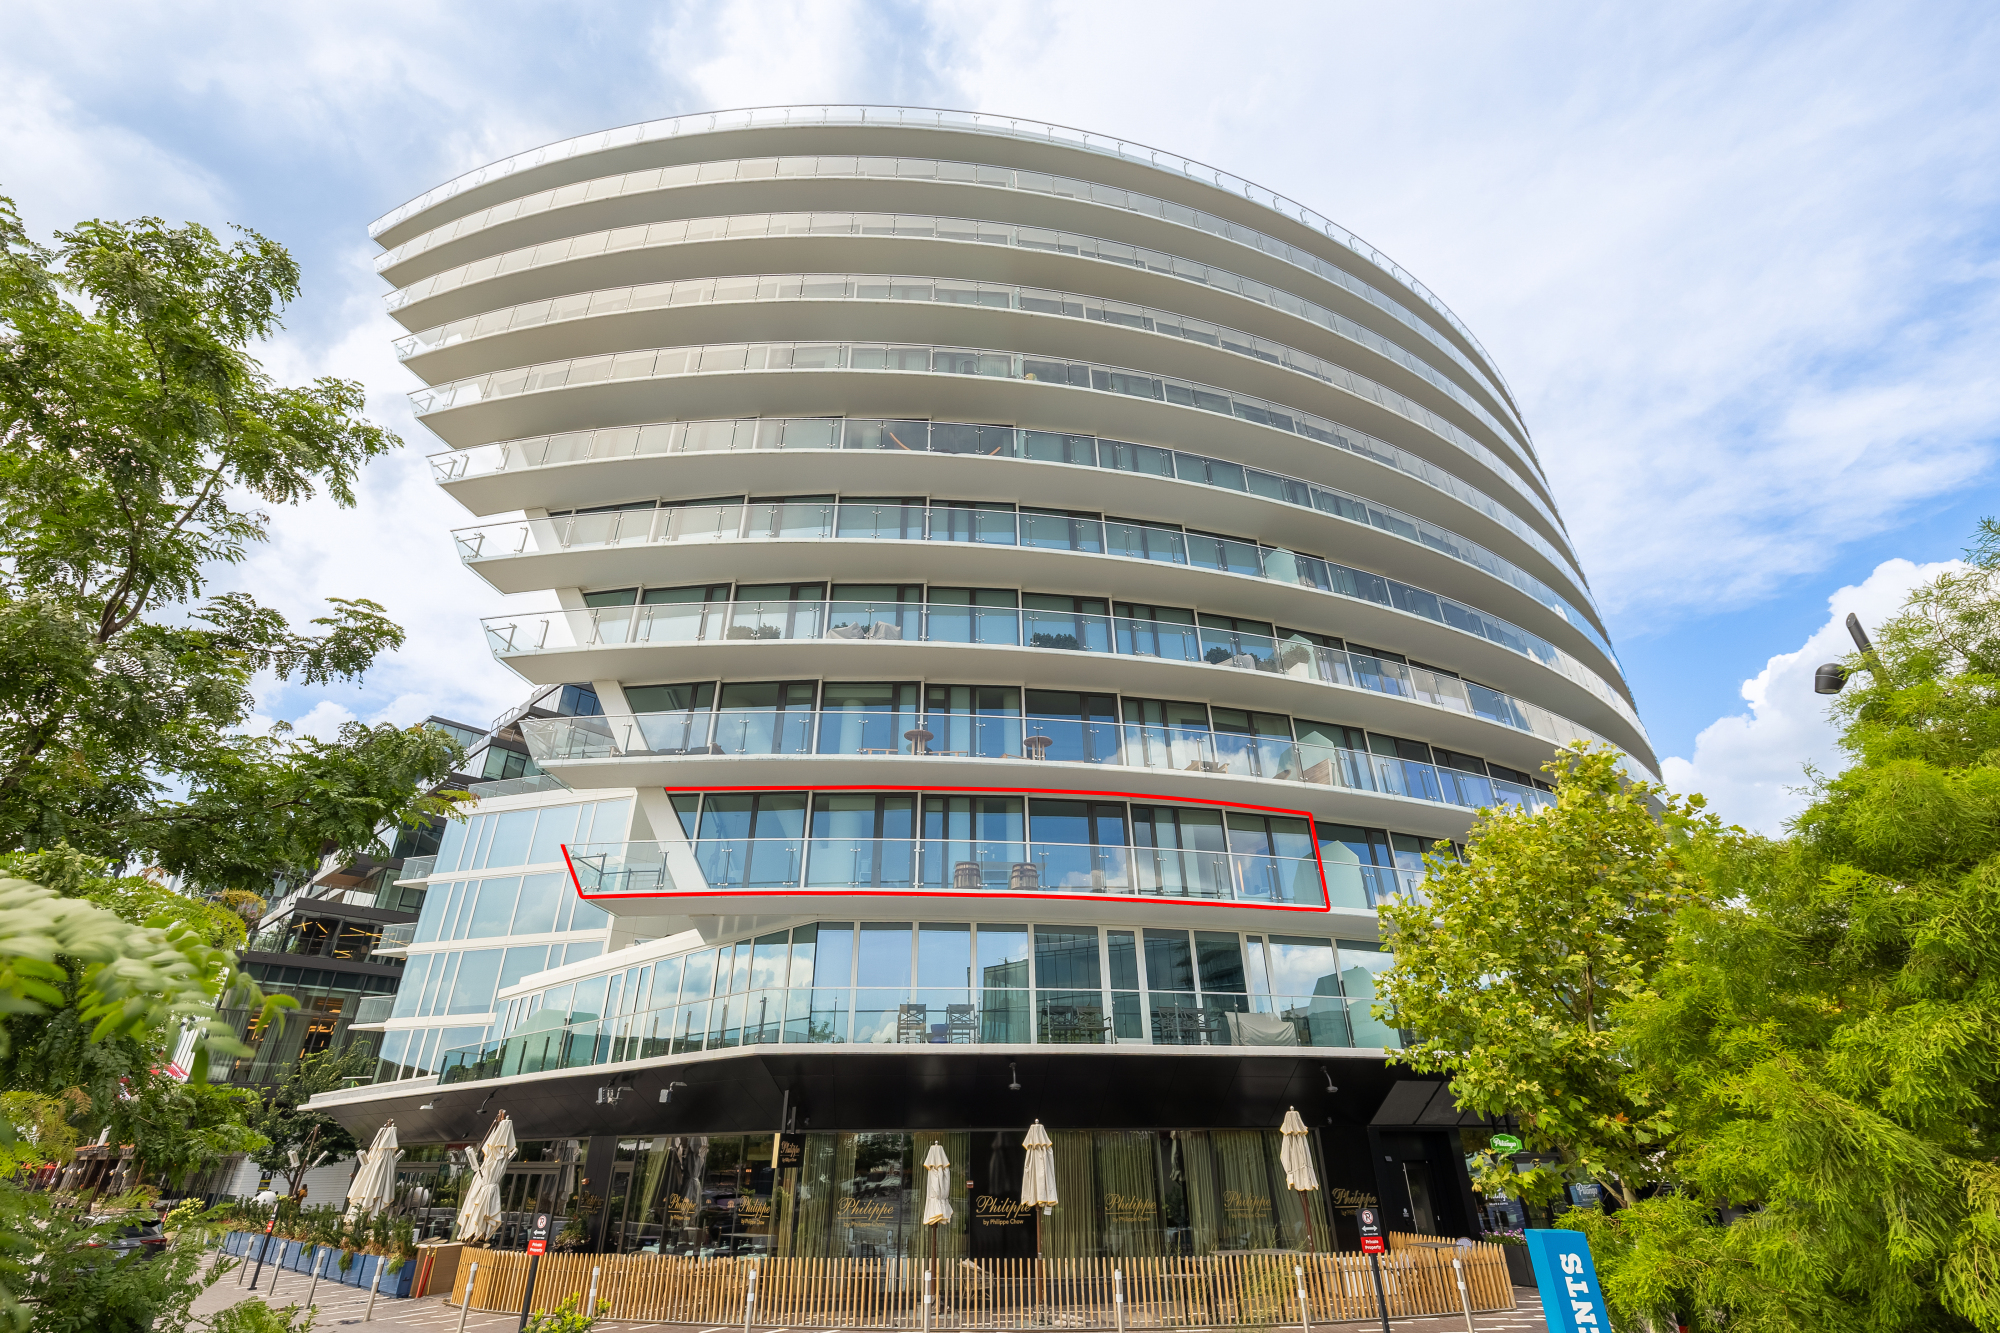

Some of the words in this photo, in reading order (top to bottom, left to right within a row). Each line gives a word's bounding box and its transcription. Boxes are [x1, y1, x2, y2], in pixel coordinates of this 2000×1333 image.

[738, 1195, 770, 1219] Philippe
[837, 1197, 894, 1221] Philippe
[975, 1195, 1031, 1219] Philippe
[1104, 1193, 1157, 1216] Philippe
[1223, 1190, 1272, 1212] Philippe
[1332, 1188, 1378, 1209] Philippe
[982, 1219, 990, 1227] by
[990, 1218, 1010, 1226] Philippe
